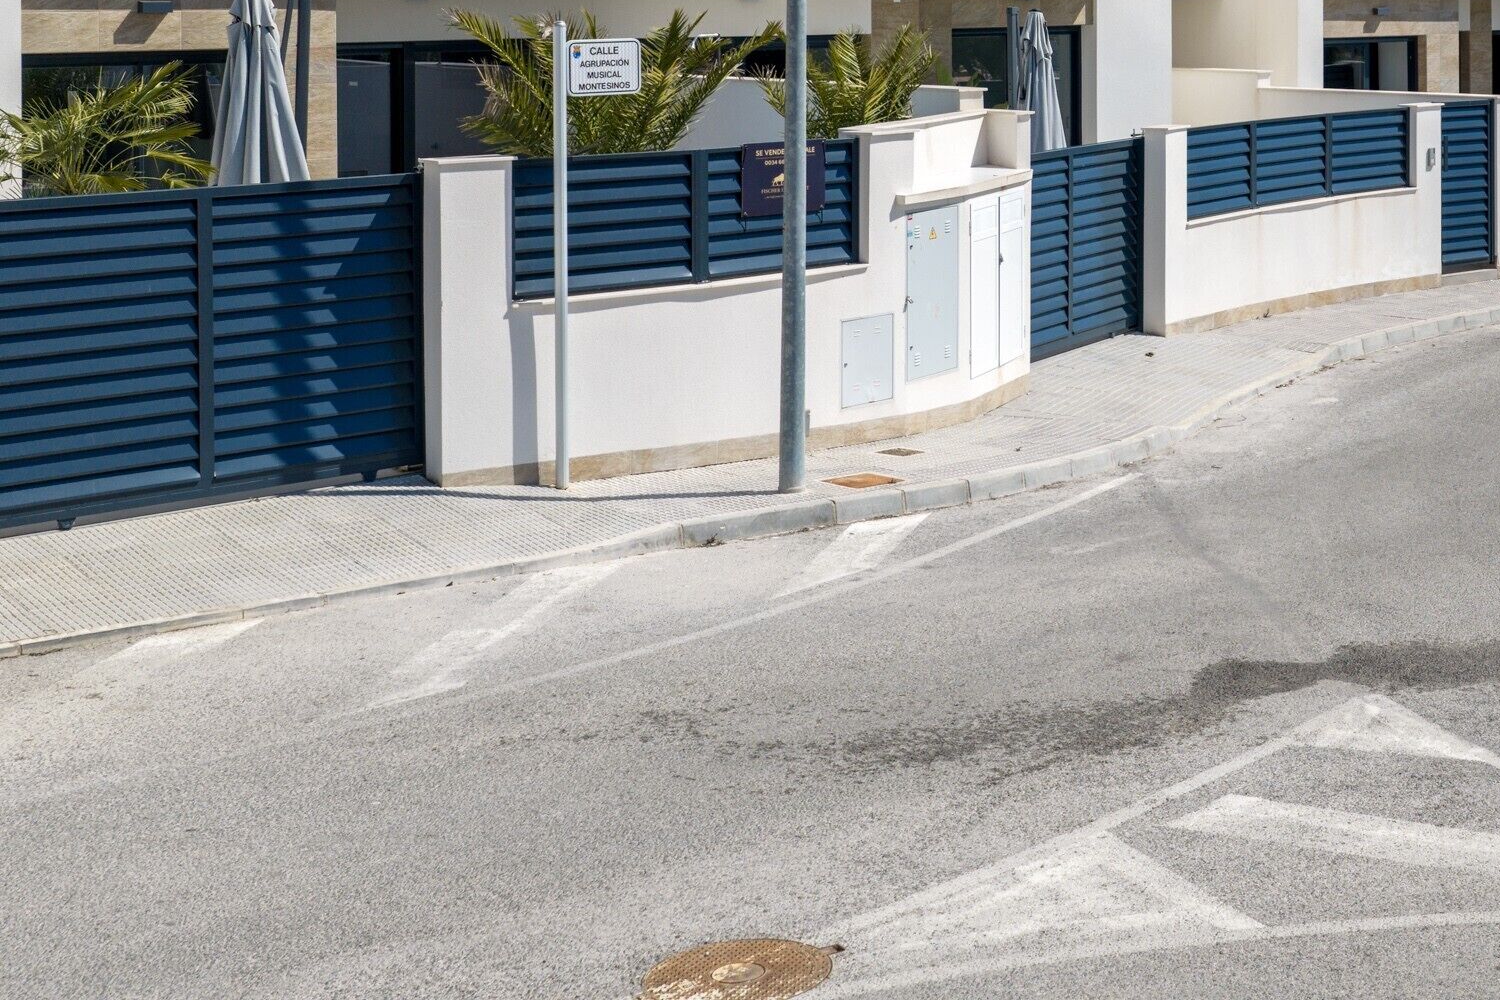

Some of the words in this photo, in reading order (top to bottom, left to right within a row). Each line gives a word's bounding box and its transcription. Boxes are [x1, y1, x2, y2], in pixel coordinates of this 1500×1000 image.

[589, 46, 619, 55] CALLE
[579, 58, 630, 68] AGRUPACIÓN
[587, 70, 622, 79] MUSICAL
[578, 81, 631, 91] MONTESINOS
[755, 149, 763, 157] SE
[764, 148, 785, 156] VENDE
